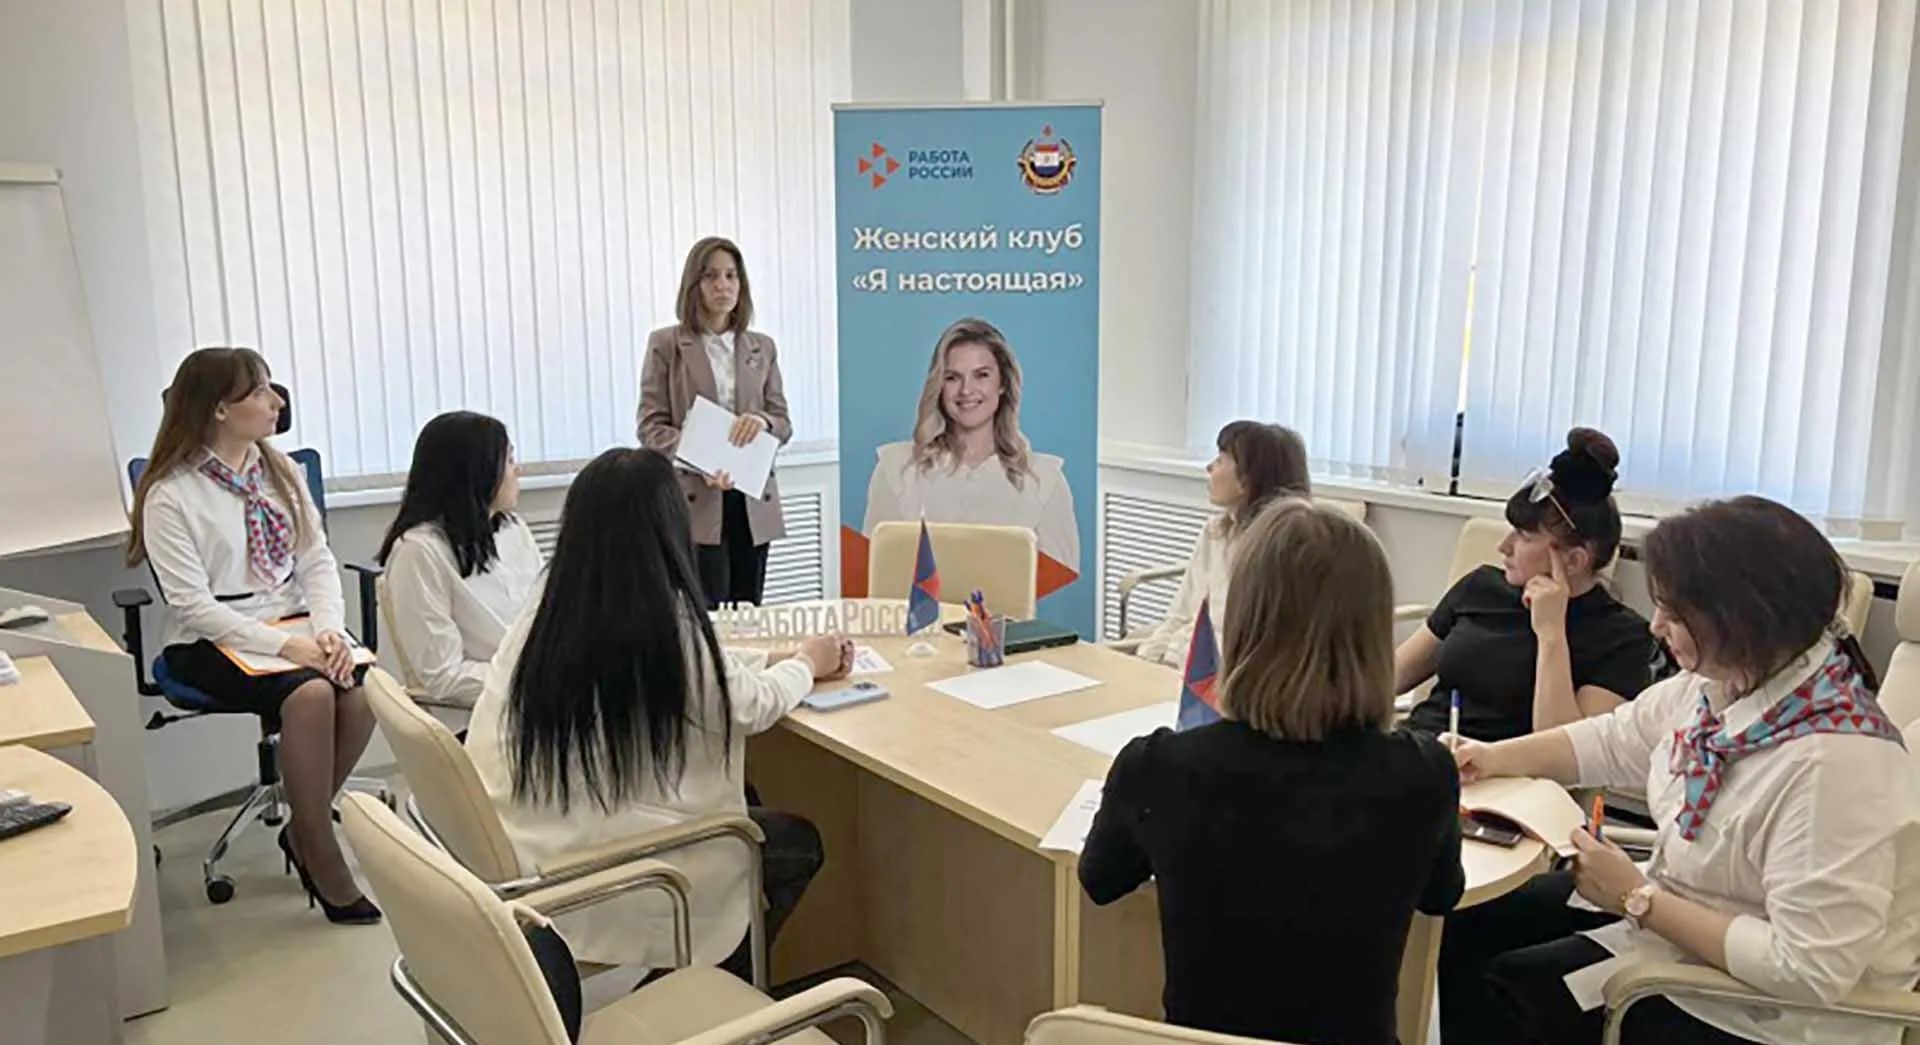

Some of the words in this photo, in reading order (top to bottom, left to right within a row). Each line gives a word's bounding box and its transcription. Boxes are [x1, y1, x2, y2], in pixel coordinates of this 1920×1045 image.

[908, 150, 969, 163] РАБОТА
[908, 166, 973, 179] РОССИИ
[853, 226, 997, 250] Женский
[1008, 223, 1082, 253] клуб
[852, 269, 888, 291] «Я
[899, 271, 1084, 293] настоящая»
